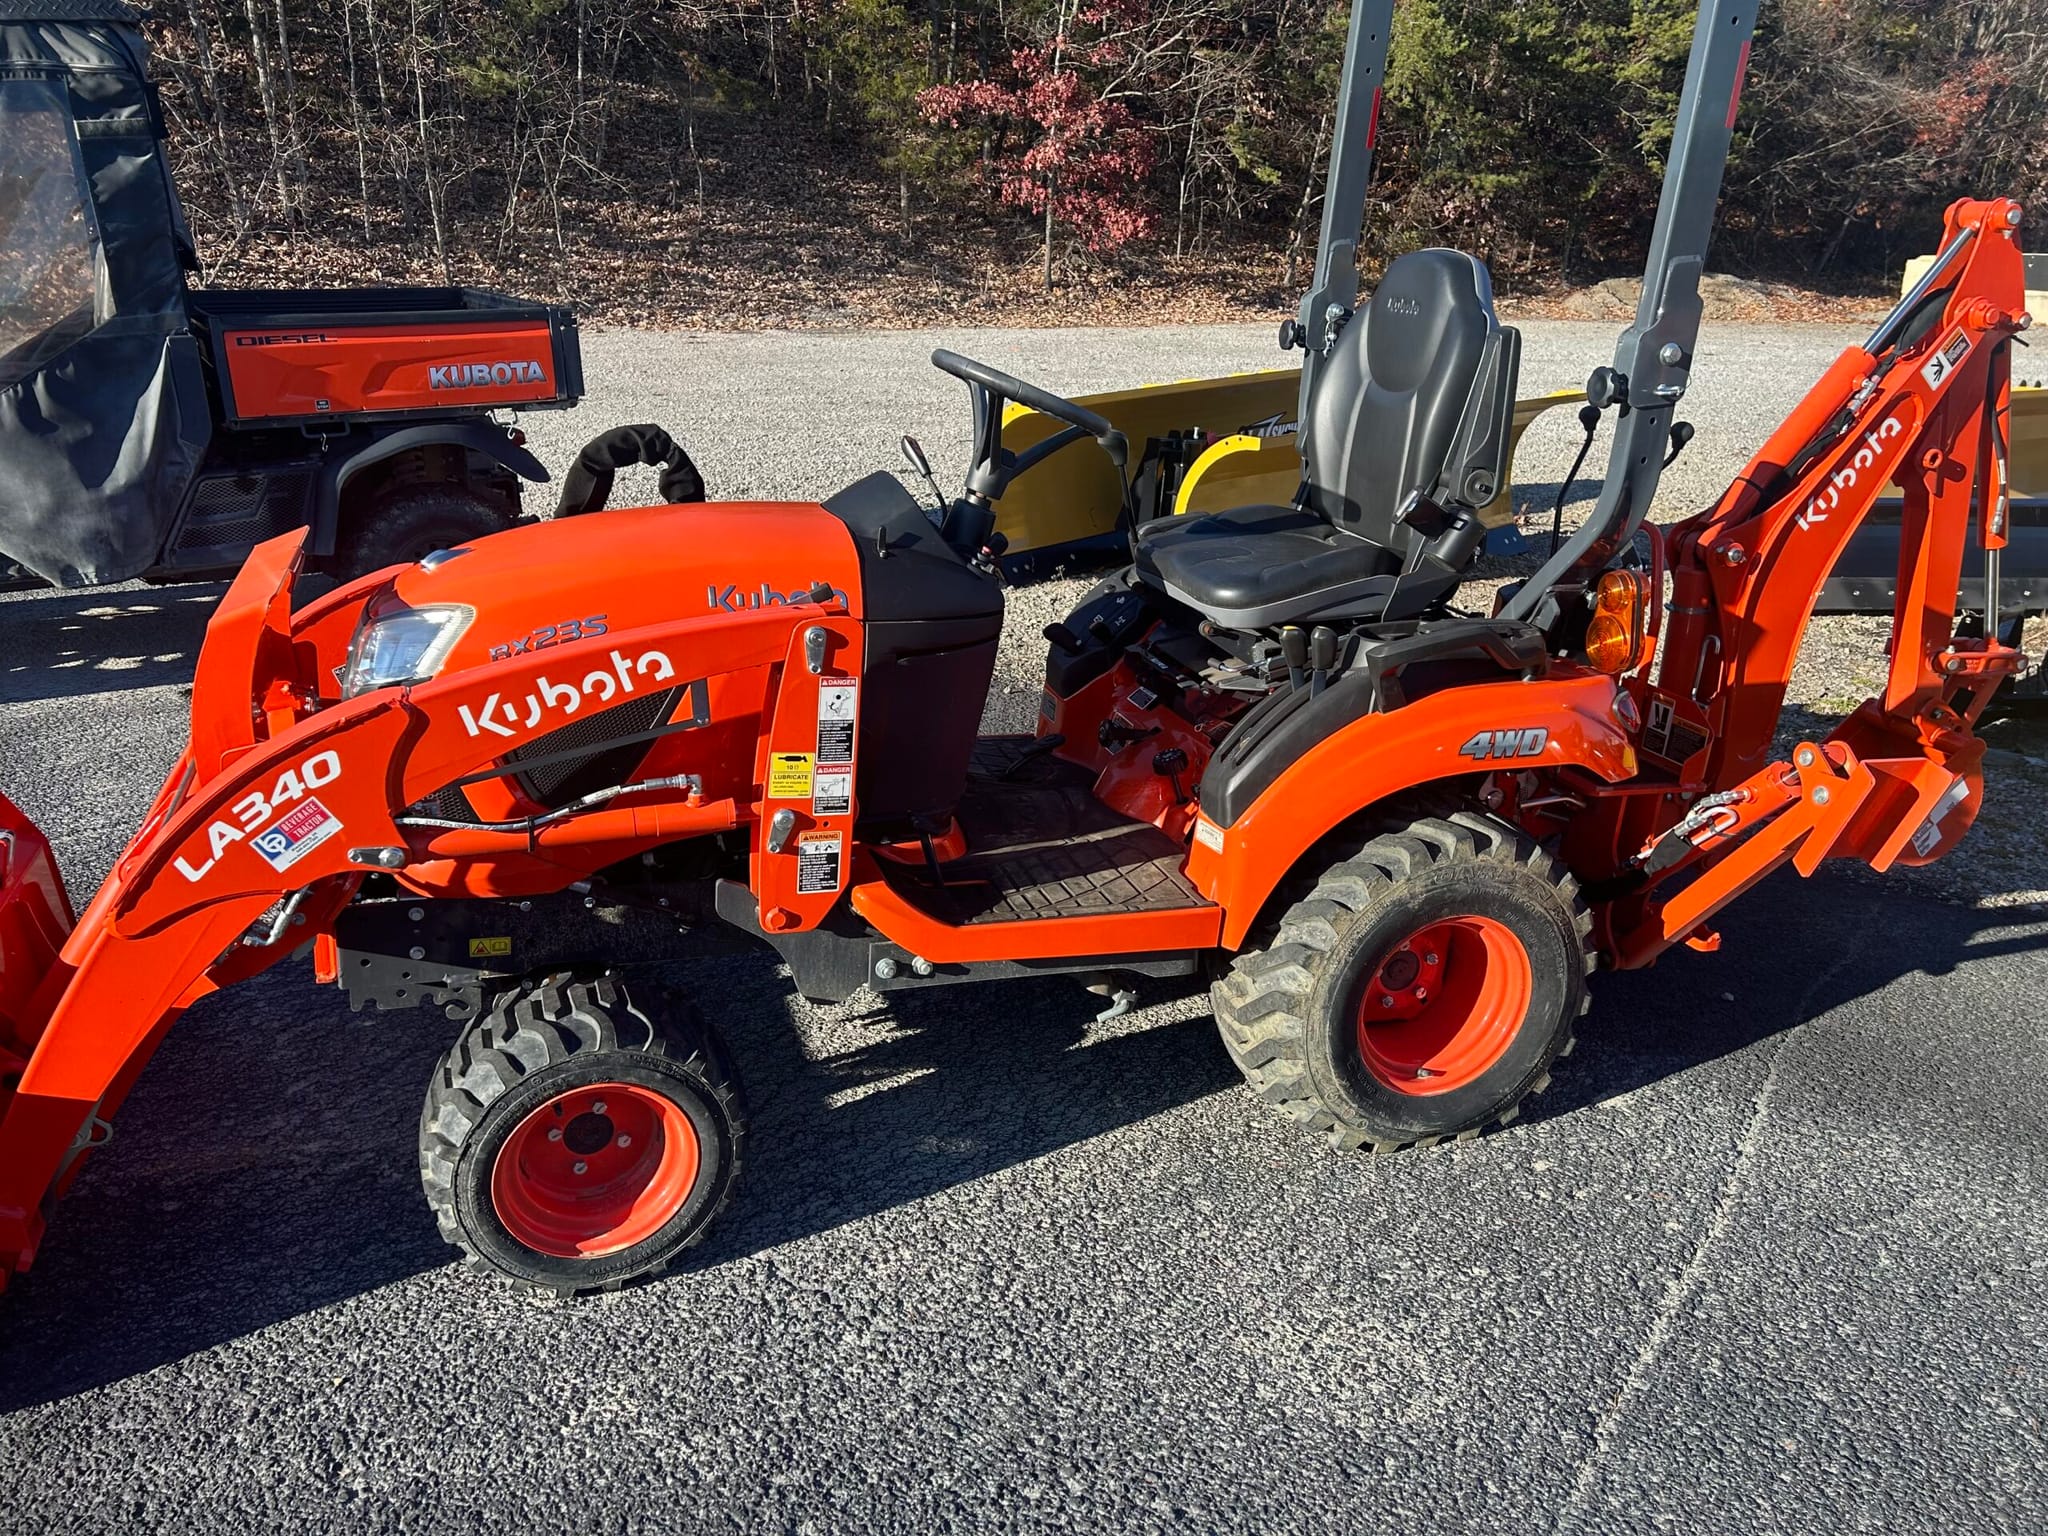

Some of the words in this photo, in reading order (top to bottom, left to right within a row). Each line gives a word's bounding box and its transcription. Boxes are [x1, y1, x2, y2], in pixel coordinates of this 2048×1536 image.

[236, 334, 337, 346] DIESEL
[428, 361, 546, 390] KUBOTA
[1795, 417, 1902, 531] Kubota
[489, 614, 608, 662] RX23S
[457, 649, 676, 738] Kubota
[1459, 727, 1549, 760] 4WD
[173, 750, 342, 883] LA340
[280, 802, 319, 832] BEVERAGE
[293, 813, 325, 838] TRACTOR
